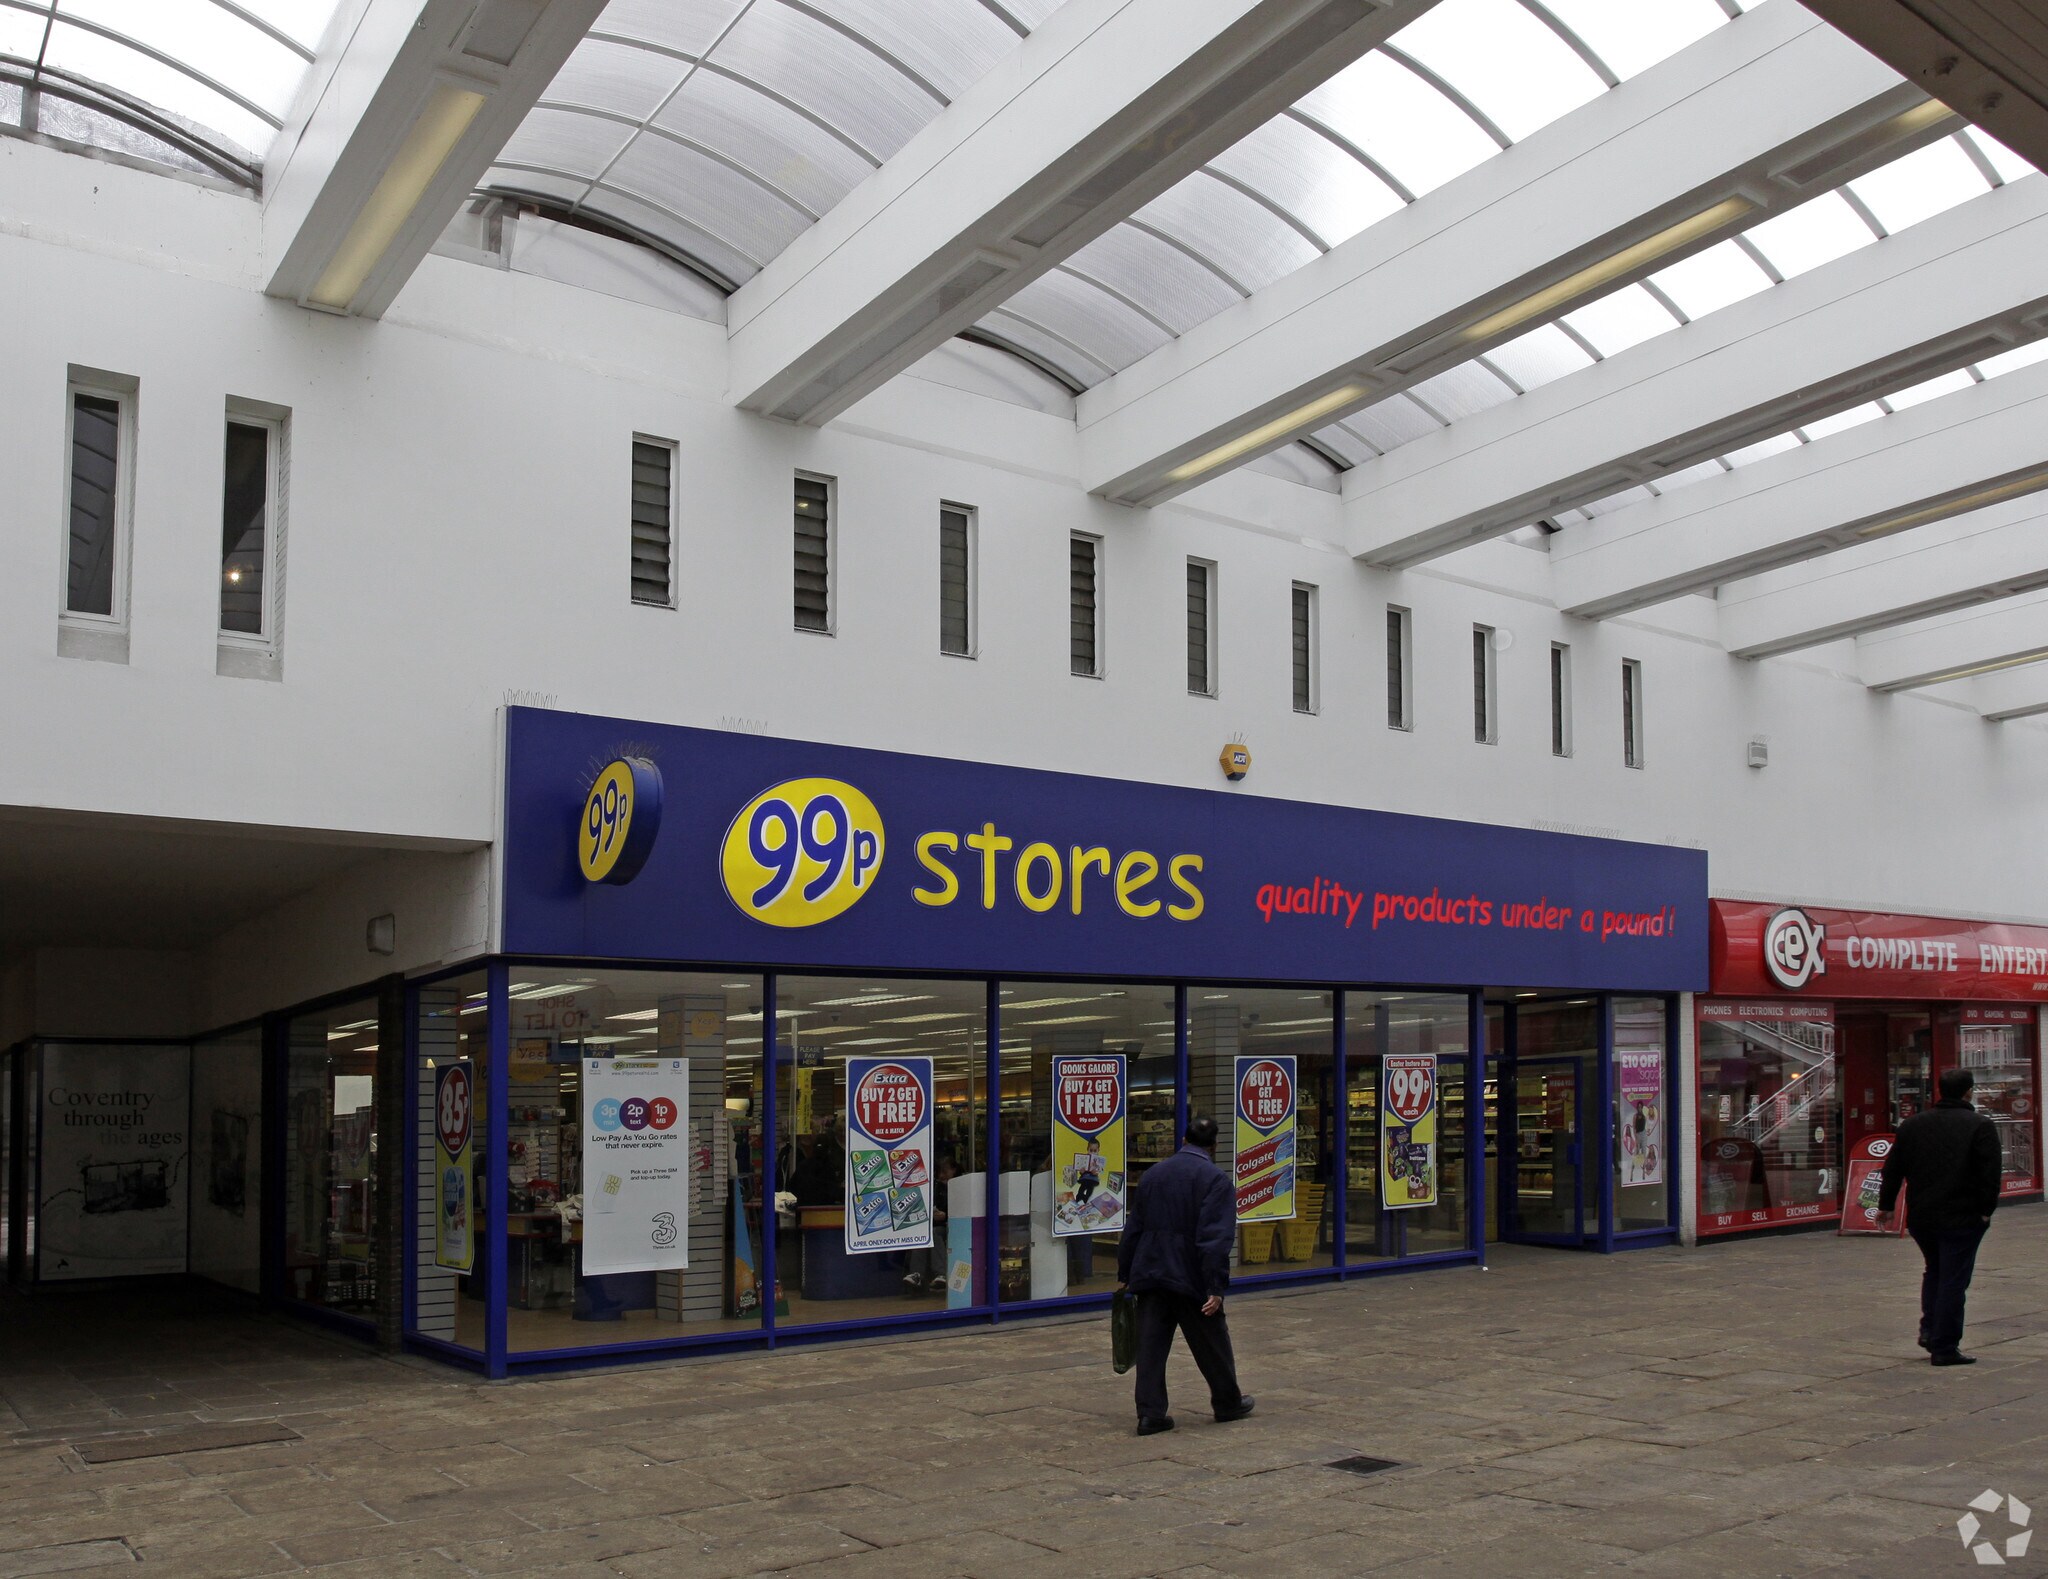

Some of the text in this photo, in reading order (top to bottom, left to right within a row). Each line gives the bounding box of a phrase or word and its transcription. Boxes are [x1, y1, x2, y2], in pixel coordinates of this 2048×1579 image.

[589, 778, 627, 867] 99p
[748, 793, 1205, 921] 99p stores
[1256, 875, 1364, 928] quality
[1372, 885, 1493, 930] products
[1502, 895, 1572, 930] under
[1580, 909, 1594, 932] a
[1846, 936, 2048, 976] COMPLETE ENTERT
[1703, 1005, 1828, 1017] PHONES ELECTRONICS COMPUTING
[1984, 1010, 2004, 1019] GAMING
[2010, 1010, 2028, 1019] VISION
[1062, 1063, 1116, 1075] BOOKS GALORE
[1622, 1054, 1658, 1068] £10 OFF
[873, 1072, 908, 1084] Extra
[1065, 1079, 1112, 1094] BUY 2 GET
[1249, 1070, 1283, 1087] BUY 2
[48, 1086, 155, 1110] Coventry
[861, 1086, 918, 1102] BUY 2 GET
[1258, 1086, 1273, 1098] GET
[1393, 1069, 1430, 1108] 99p
[441, 1081, 468, 1134] 85p
[601, 1103, 668, 1118] 3p 2p 1p
[862, 1102, 916, 1124] 1 FREE
[1065, 1093, 1111, 1115] 1 FREE
[1248, 1098, 1283, 1115] 1 FREE
[1403, 1108, 1419, 1116] each
[64, 1110, 144, 1130] through
[100, 1130, 183, 1149] the ages
[448, 1135, 460, 1145] each
[608, 1134, 621, 1143] Pay
[634, 1133, 647, 1141] You
[641, 1141, 664, 1149] expire.
[857, 1154, 882, 1177] Extra
[894, 1152, 919, 1173] Extra
[1236, 1151, 1274, 1173] Colgate
[1818, 1168, 1829, 1194] 2
[2006, 1179, 2032, 1190] EXCHANGE
[894, 1191, 918, 1214] Extra
[1235, 1185, 1273, 1208] Colgate
[1861, 1191, 1880, 1203] CAS
[859, 1197, 883, 1218] Extra
[1718, 1204, 1820, 1226] BUY SELL EXCHANGE
